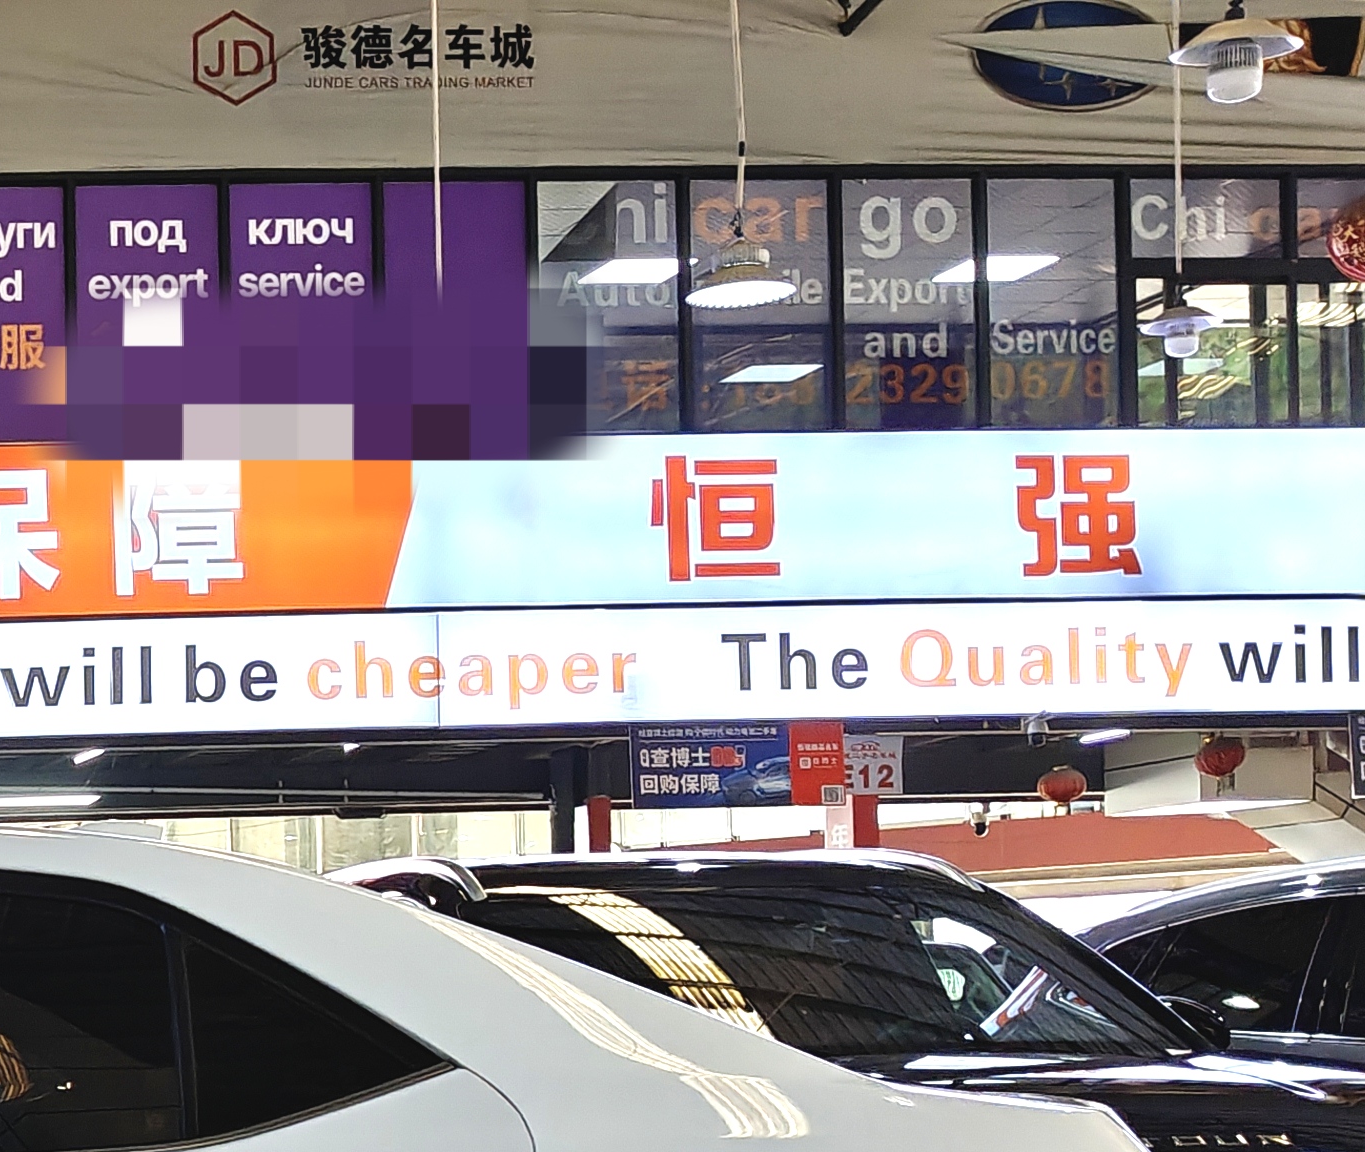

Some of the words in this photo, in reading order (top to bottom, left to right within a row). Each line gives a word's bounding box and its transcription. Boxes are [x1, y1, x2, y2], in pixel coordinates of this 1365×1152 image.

[203, 39, 262, 77] JD
[301, 24, 534, 69] 骏德名车城
[304, 77, 355, 89] JUNDE
[358, 77, 400, 89] CARS
[474, 76, 535, 88] MARKET
[108, 218, 187, 253] под
[247, 216, 354, 246] ключ
[858, 195, 958, 260] go
[87, 267, 209, 308] export
[237, 264, 366, 298] service
[864, 321, 949, 359] and
[991, 318, 1117, 356] Service
[0, 645, 154, 709] will
[184, 644, 279, 705] be
[306, 640, 637, 710] cheaper
[719, 631, 870, 691] The
[899, 626, 1194, 699] Quality
[1218, 622, 1361, 684] will
[640, 774, 721, 794] 回购保障
